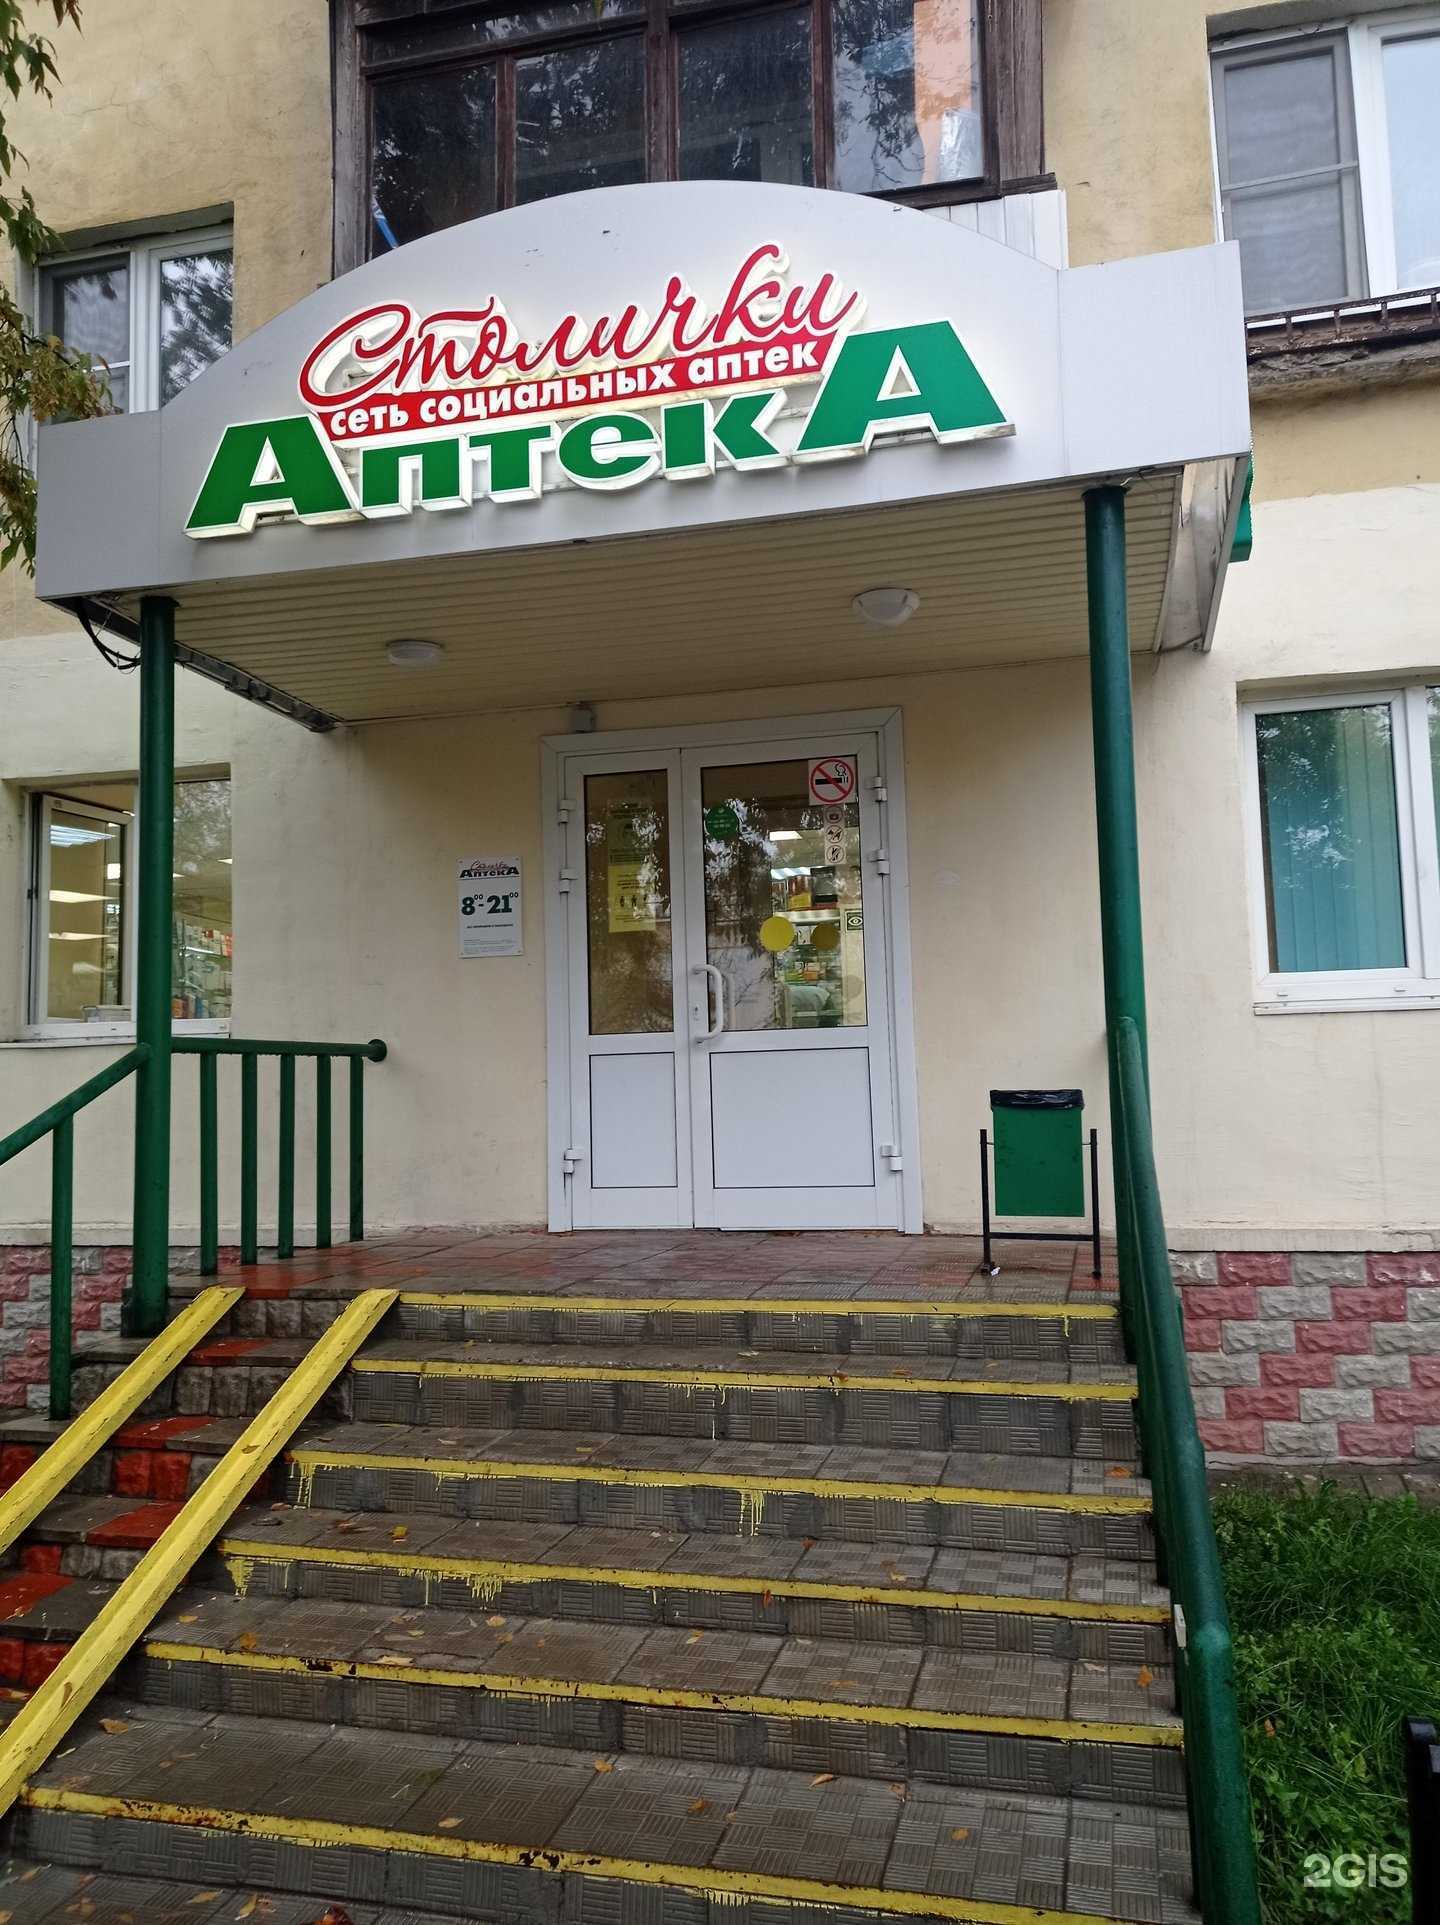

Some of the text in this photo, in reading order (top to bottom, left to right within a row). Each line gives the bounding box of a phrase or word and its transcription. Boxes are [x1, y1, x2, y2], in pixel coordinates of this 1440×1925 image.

[298, 243, 859, 408] Столички
[330, 341, 819, 436] сеть социальных аптек
